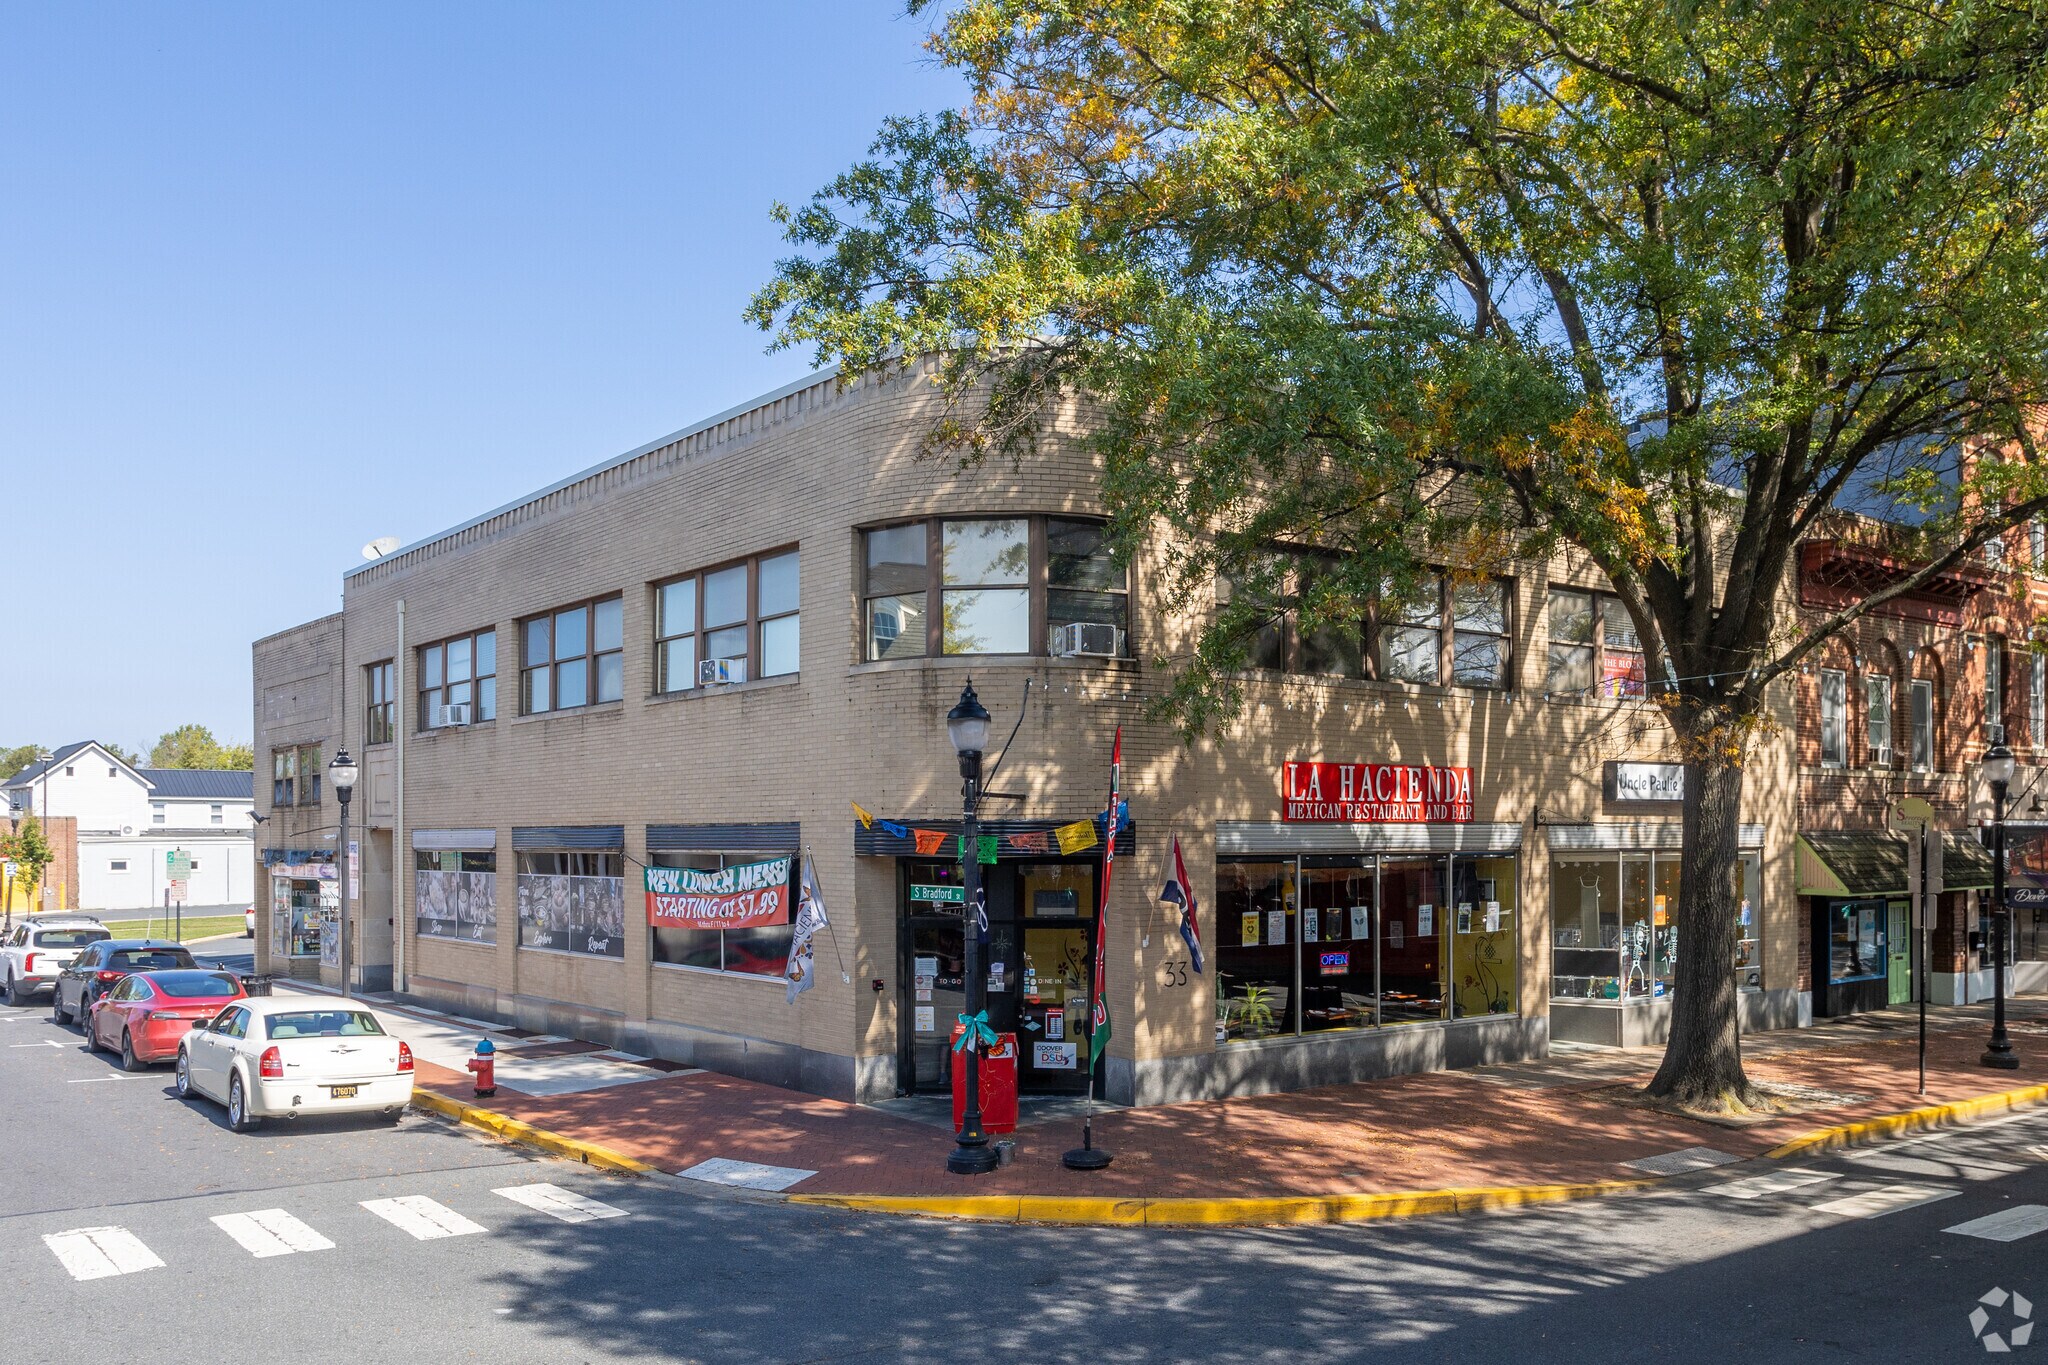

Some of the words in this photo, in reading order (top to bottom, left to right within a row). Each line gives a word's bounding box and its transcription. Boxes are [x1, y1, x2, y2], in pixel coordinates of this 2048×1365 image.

[1604, 658, 1617, 667] THE
[1618, 659, 1642, 670] BLOCK
[1288, 764, 1323, 801] LA
[1339, 765, 1473, 803] HACIENDA
[1619, 773, 1647, 790] Uncle
[1649, 775, 1684, 791] Paulie'
[1288, 802, 1342, 819] MEXICAN
[1346, 803, 1421, 820] RESTAURANT
[1426, 804, 1448, 820] AND
[1452, 804, 1473, 820] BAR
[647, 869, 680, 893] NEW
[683, 868, 735, 893] LUNCH
[738, 859, 788, 891] MENU
[914, 887, 920, 898] S
[922, 888, 952, 900] Bradford
[2014, 888, 2048, 902] Dover
[656, 896, 719, 919] STARTING
[719, 898, 735, 918] at
[738, 890, 779, 920] $7.99
[588, 936, 609, 953] Repeat
[1321, 955, 1348, 966] OPEN
[1164, 961, 1187, 987] 33
[1041, 1053, 1063, 1062] DSU
[333, 1087, 356, 1096] 476070
